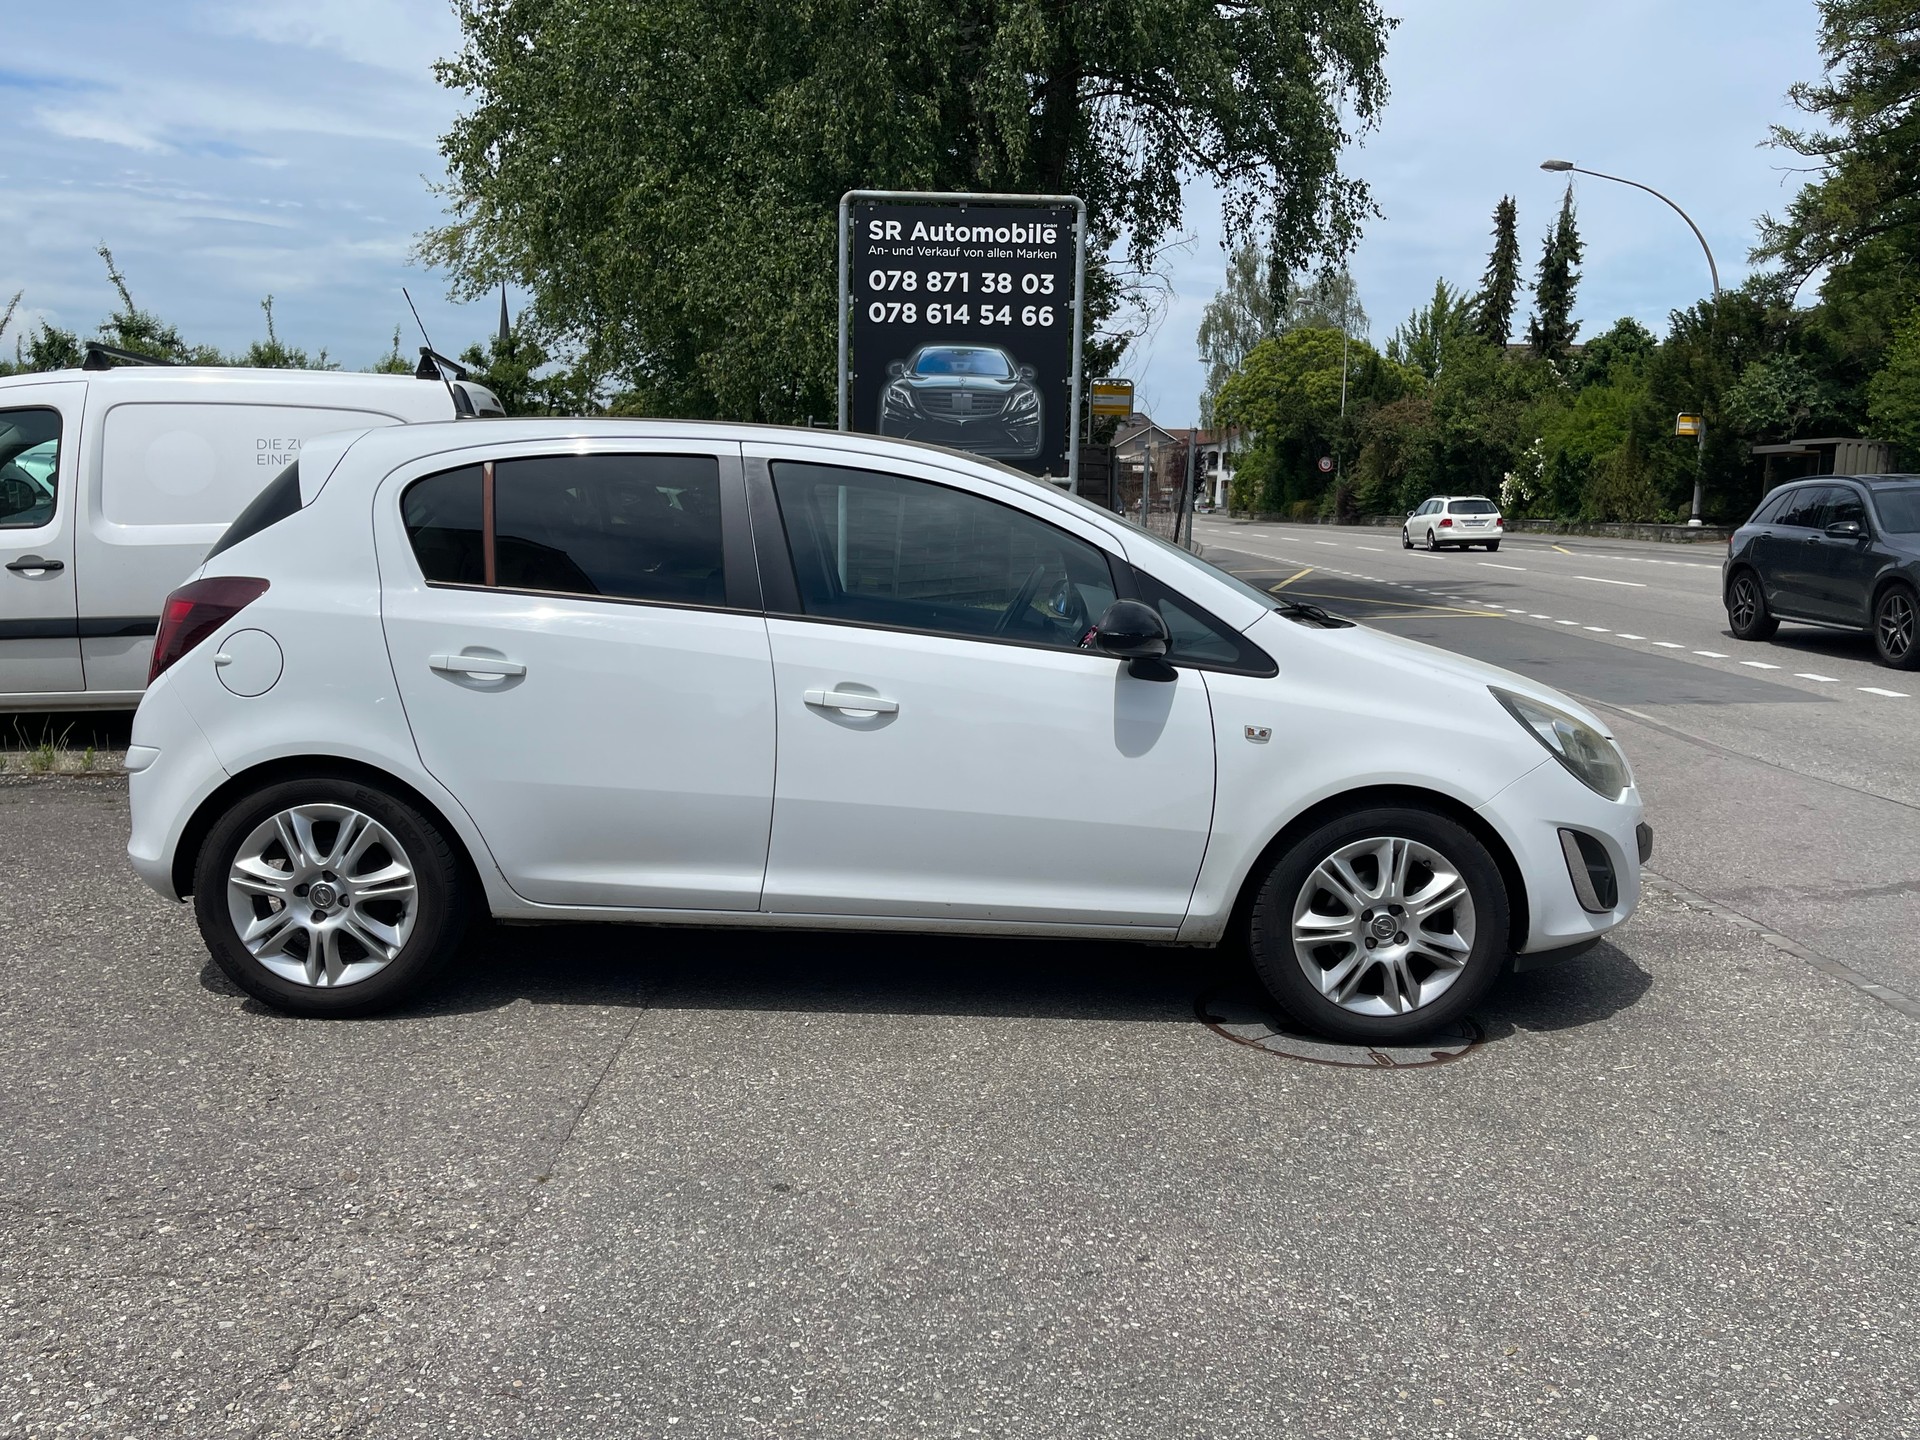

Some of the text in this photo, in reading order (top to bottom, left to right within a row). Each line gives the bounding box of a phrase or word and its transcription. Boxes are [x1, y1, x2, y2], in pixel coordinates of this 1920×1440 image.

[869, 220, 902, 240] SR
[910, 222, 1057, 244] Automobile
[868, 245, 1057, 259] An- und Verkauf von allen Marken
[868, 269, 1055, 295] 078 871 38 03
[868, 302, 1054, 327] 078 614 54 66
[256, 438, 282, 450] DIE
[256, 453, 292, 465] EINF
